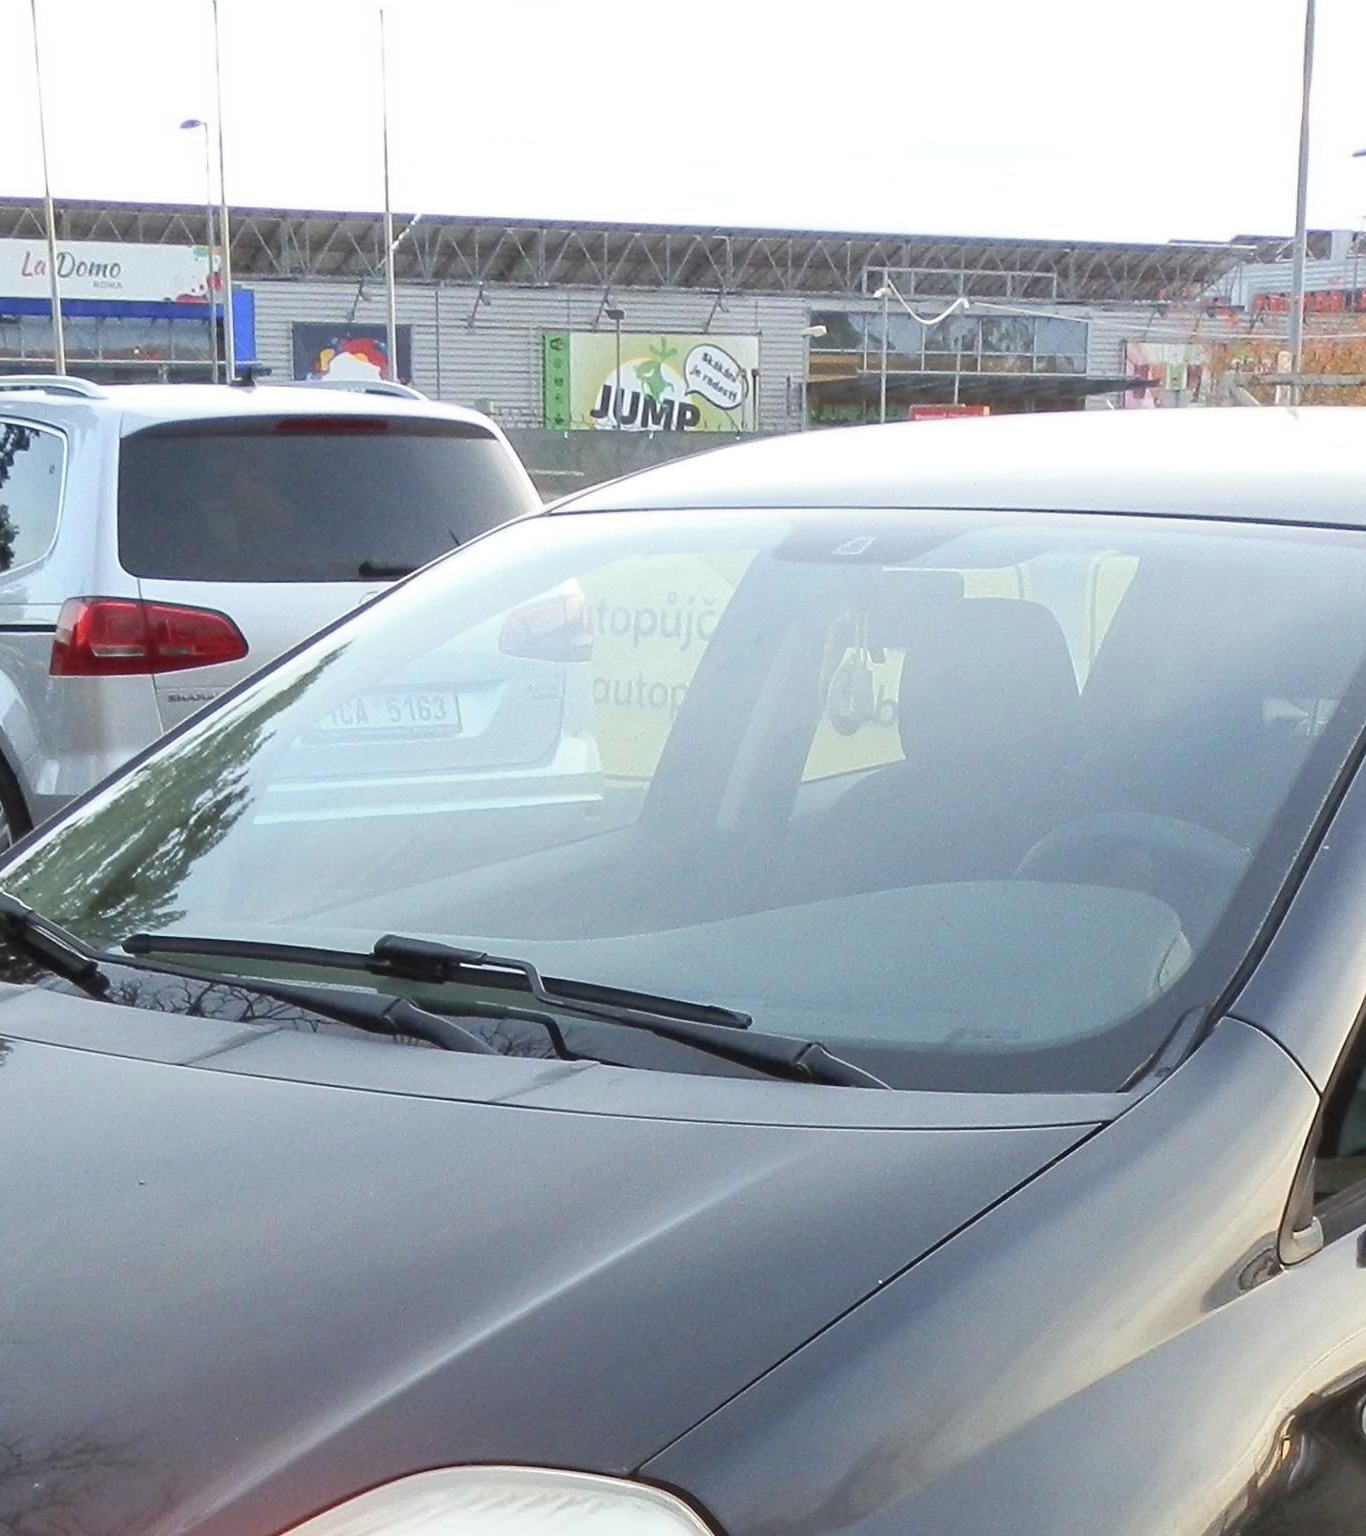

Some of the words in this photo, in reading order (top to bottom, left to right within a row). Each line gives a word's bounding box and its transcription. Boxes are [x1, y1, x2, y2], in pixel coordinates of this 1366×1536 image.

[20, 251, 46, 277] La
[55, 252, 122, 279] Domo
[589, 384, 701, 431] JUMP
[386, 694, 447, 723] 5163
